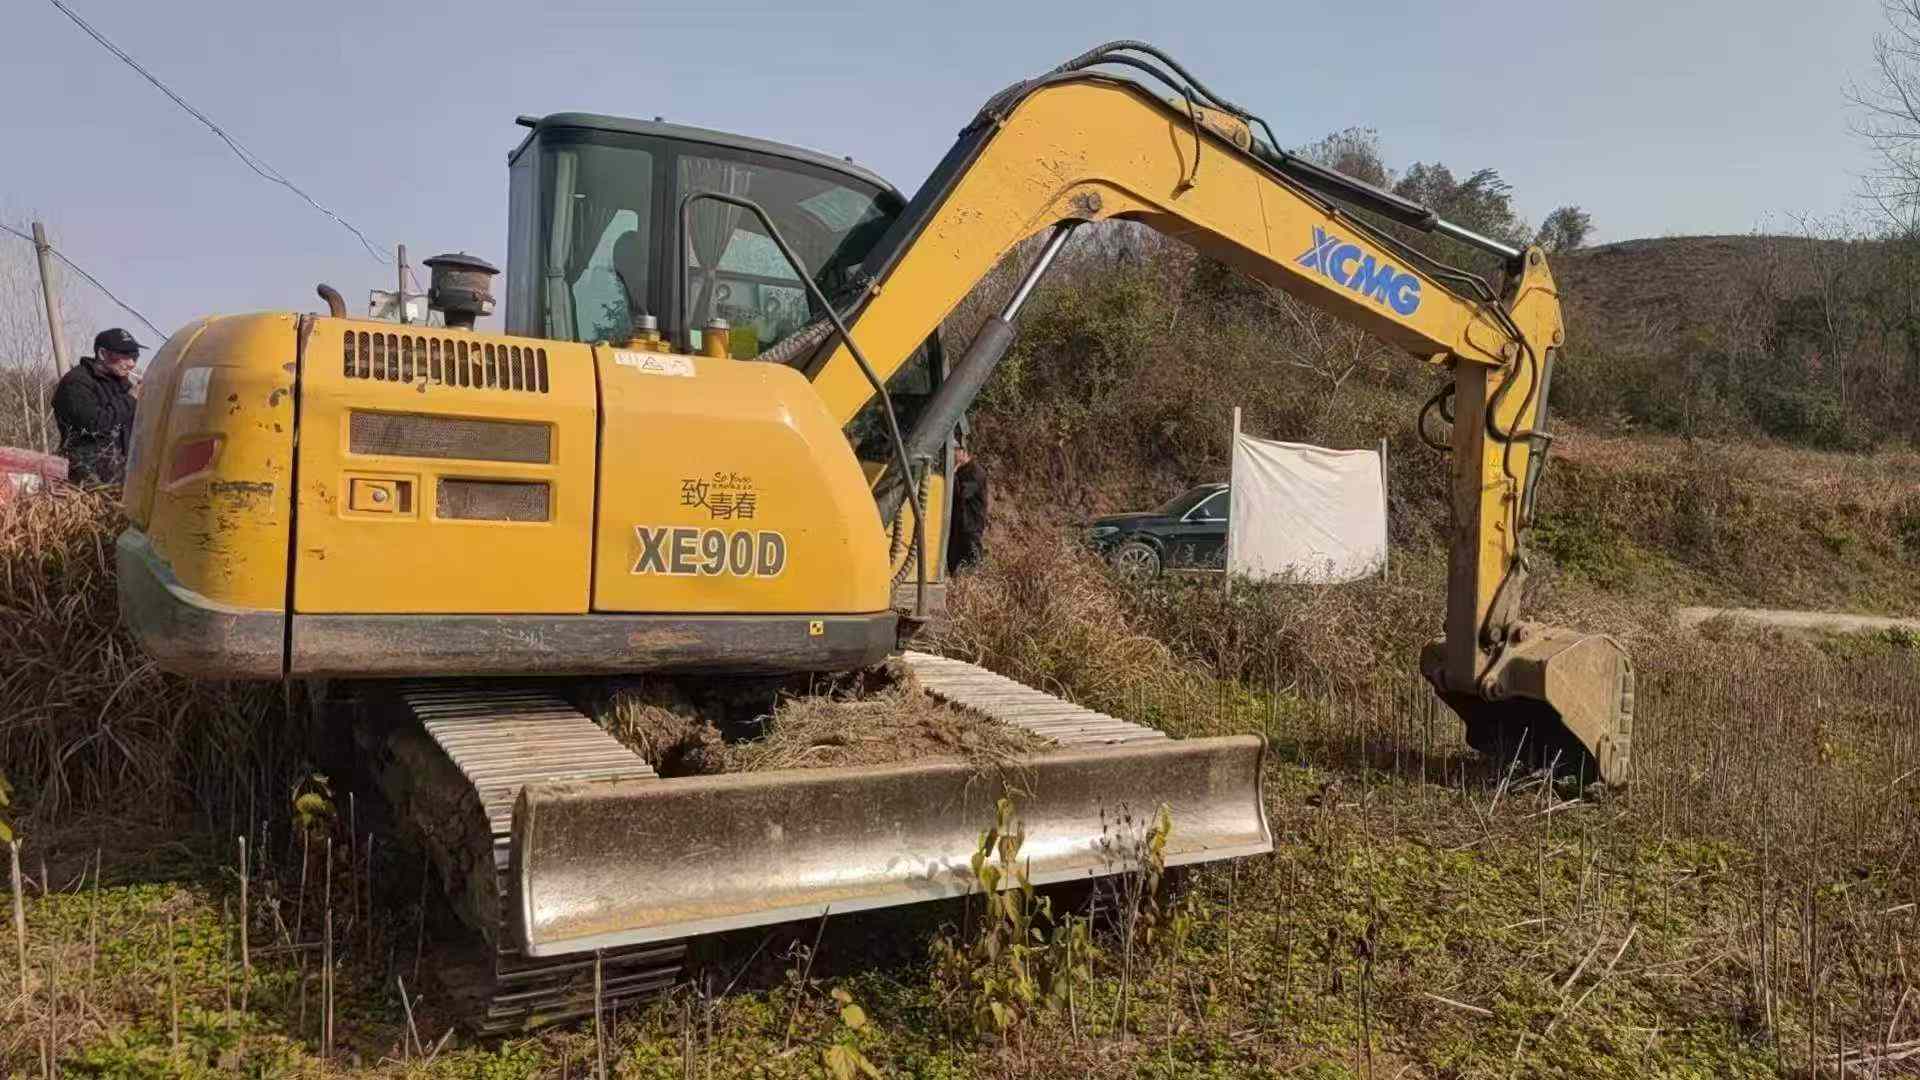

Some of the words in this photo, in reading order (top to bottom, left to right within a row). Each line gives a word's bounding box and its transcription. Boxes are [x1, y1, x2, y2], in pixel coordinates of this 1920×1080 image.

[1294, 224, 1421, 316] XCMG
[680, 478, 756, 520] 致青春
[631, 525, 786, 577] XE90D
